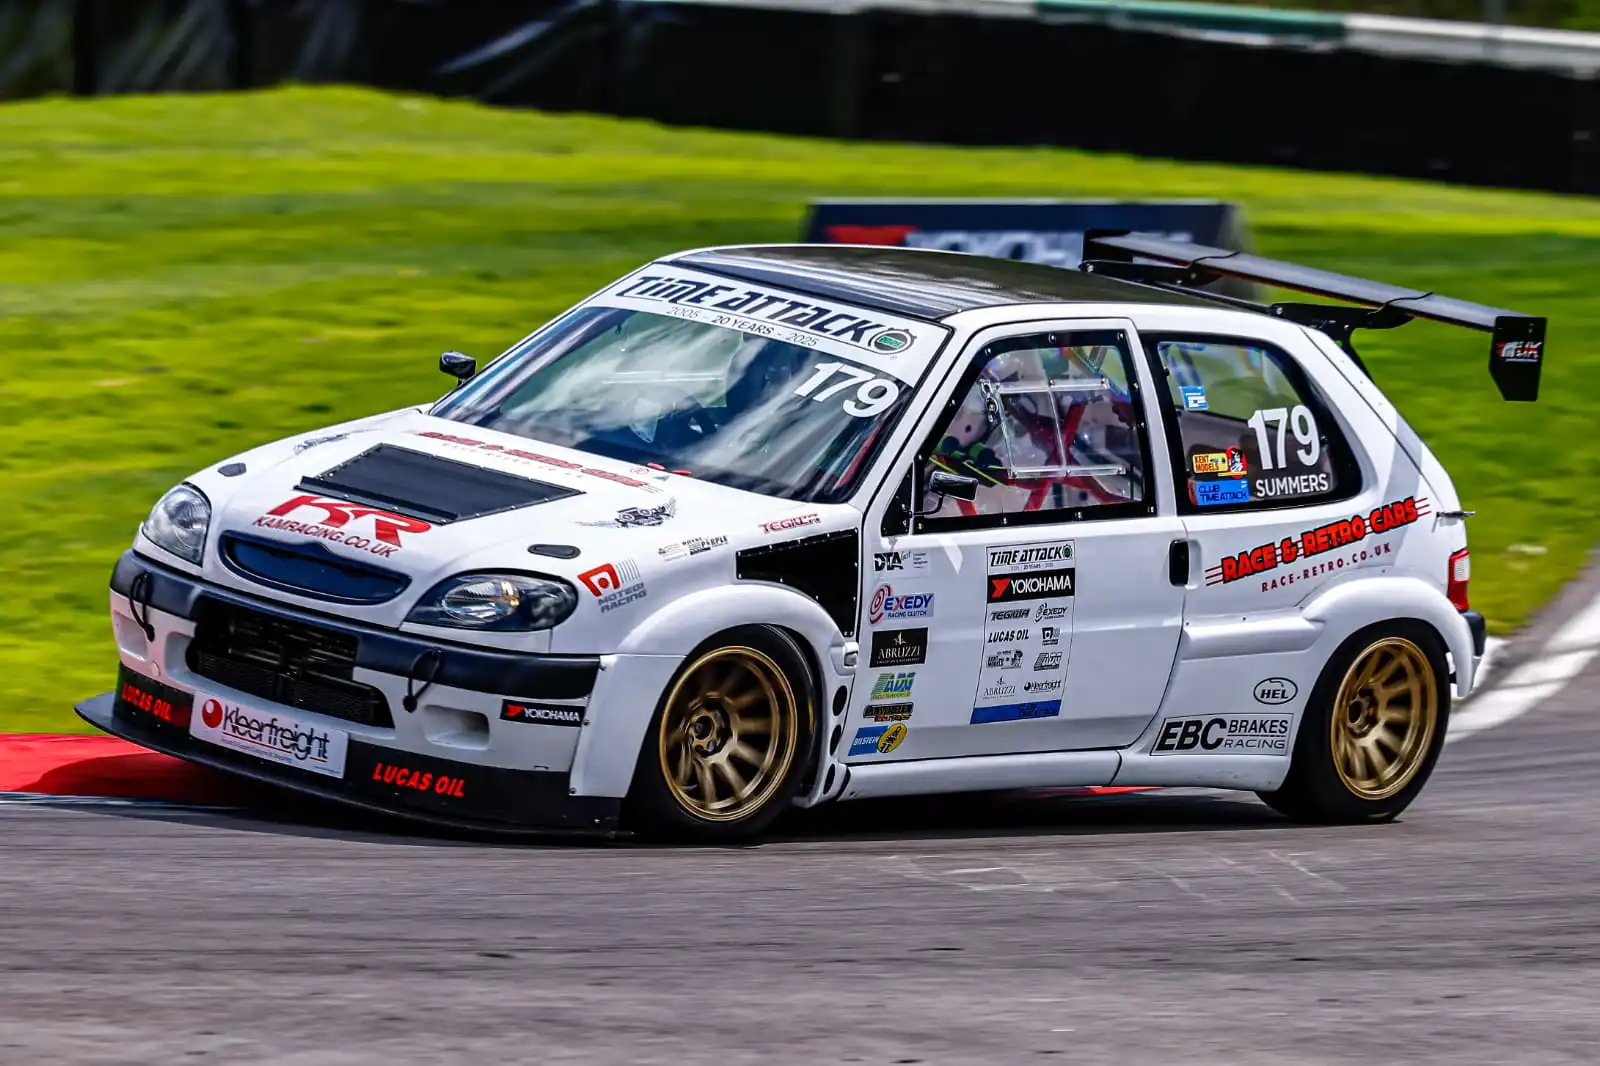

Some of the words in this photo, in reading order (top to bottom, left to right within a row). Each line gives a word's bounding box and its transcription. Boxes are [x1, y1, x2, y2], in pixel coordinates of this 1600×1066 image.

[667, 306, 700, 319] 2005
[731, 317, 774, 335] YEARS
[785, 332, 819, 347] 2025
[794, 362, 899, 418] 179
[1248, 404, 1321, 470] 179
[1195, 456, 1209, 464] KENT
[1196, 463, 1219, 472] MODELS
[1198, 485, 1219, 493] CLUB
[1256, 474, 1329, 497] SUMMERS
[252, 516, 400, 558] KAMRACING.CO.UK
[1220, 543, 1277, 583] RACE
[1280, 537, 1298, 563] &
[1301, 515, 1365, 558] RETRO
[1369, 496, 1418, 534] CARS
[874, 552, 904, 572] DTA
[1262, 543, 1391, 592] RACE-RETRO.CO.UK
[598, 582, 644, 605] MOTEGI
[1010, 575, 1072, 595] YOKOHAMA
[601, 589, 647, 613] RACING
[884, 594, 934, 612] EXEDY
[888, 611, 907, 619] RACING
[988, 630, 1015, 643] LUCAS
[1016, 629, 1029, 641] OIL
[878, 645, 920, 659] ABRUZZI
[984, 685, 1016, 696] ABRUZZI
[1260, 689, 1288, 699] HEL
[121, 681, 153, 713] LUCAS
[152, 701, 171, 721] OIL
[523, 707, 580, 721] YOKOHAMA
[1155, 718, 1227, 750] EBC
[1228, 719, 1288, 734] BRAKES
[1224, 739, 1285, 749] RACING
[372, 762, 433, 791] LUCAS
[434, 775, 465, 797] OIL
